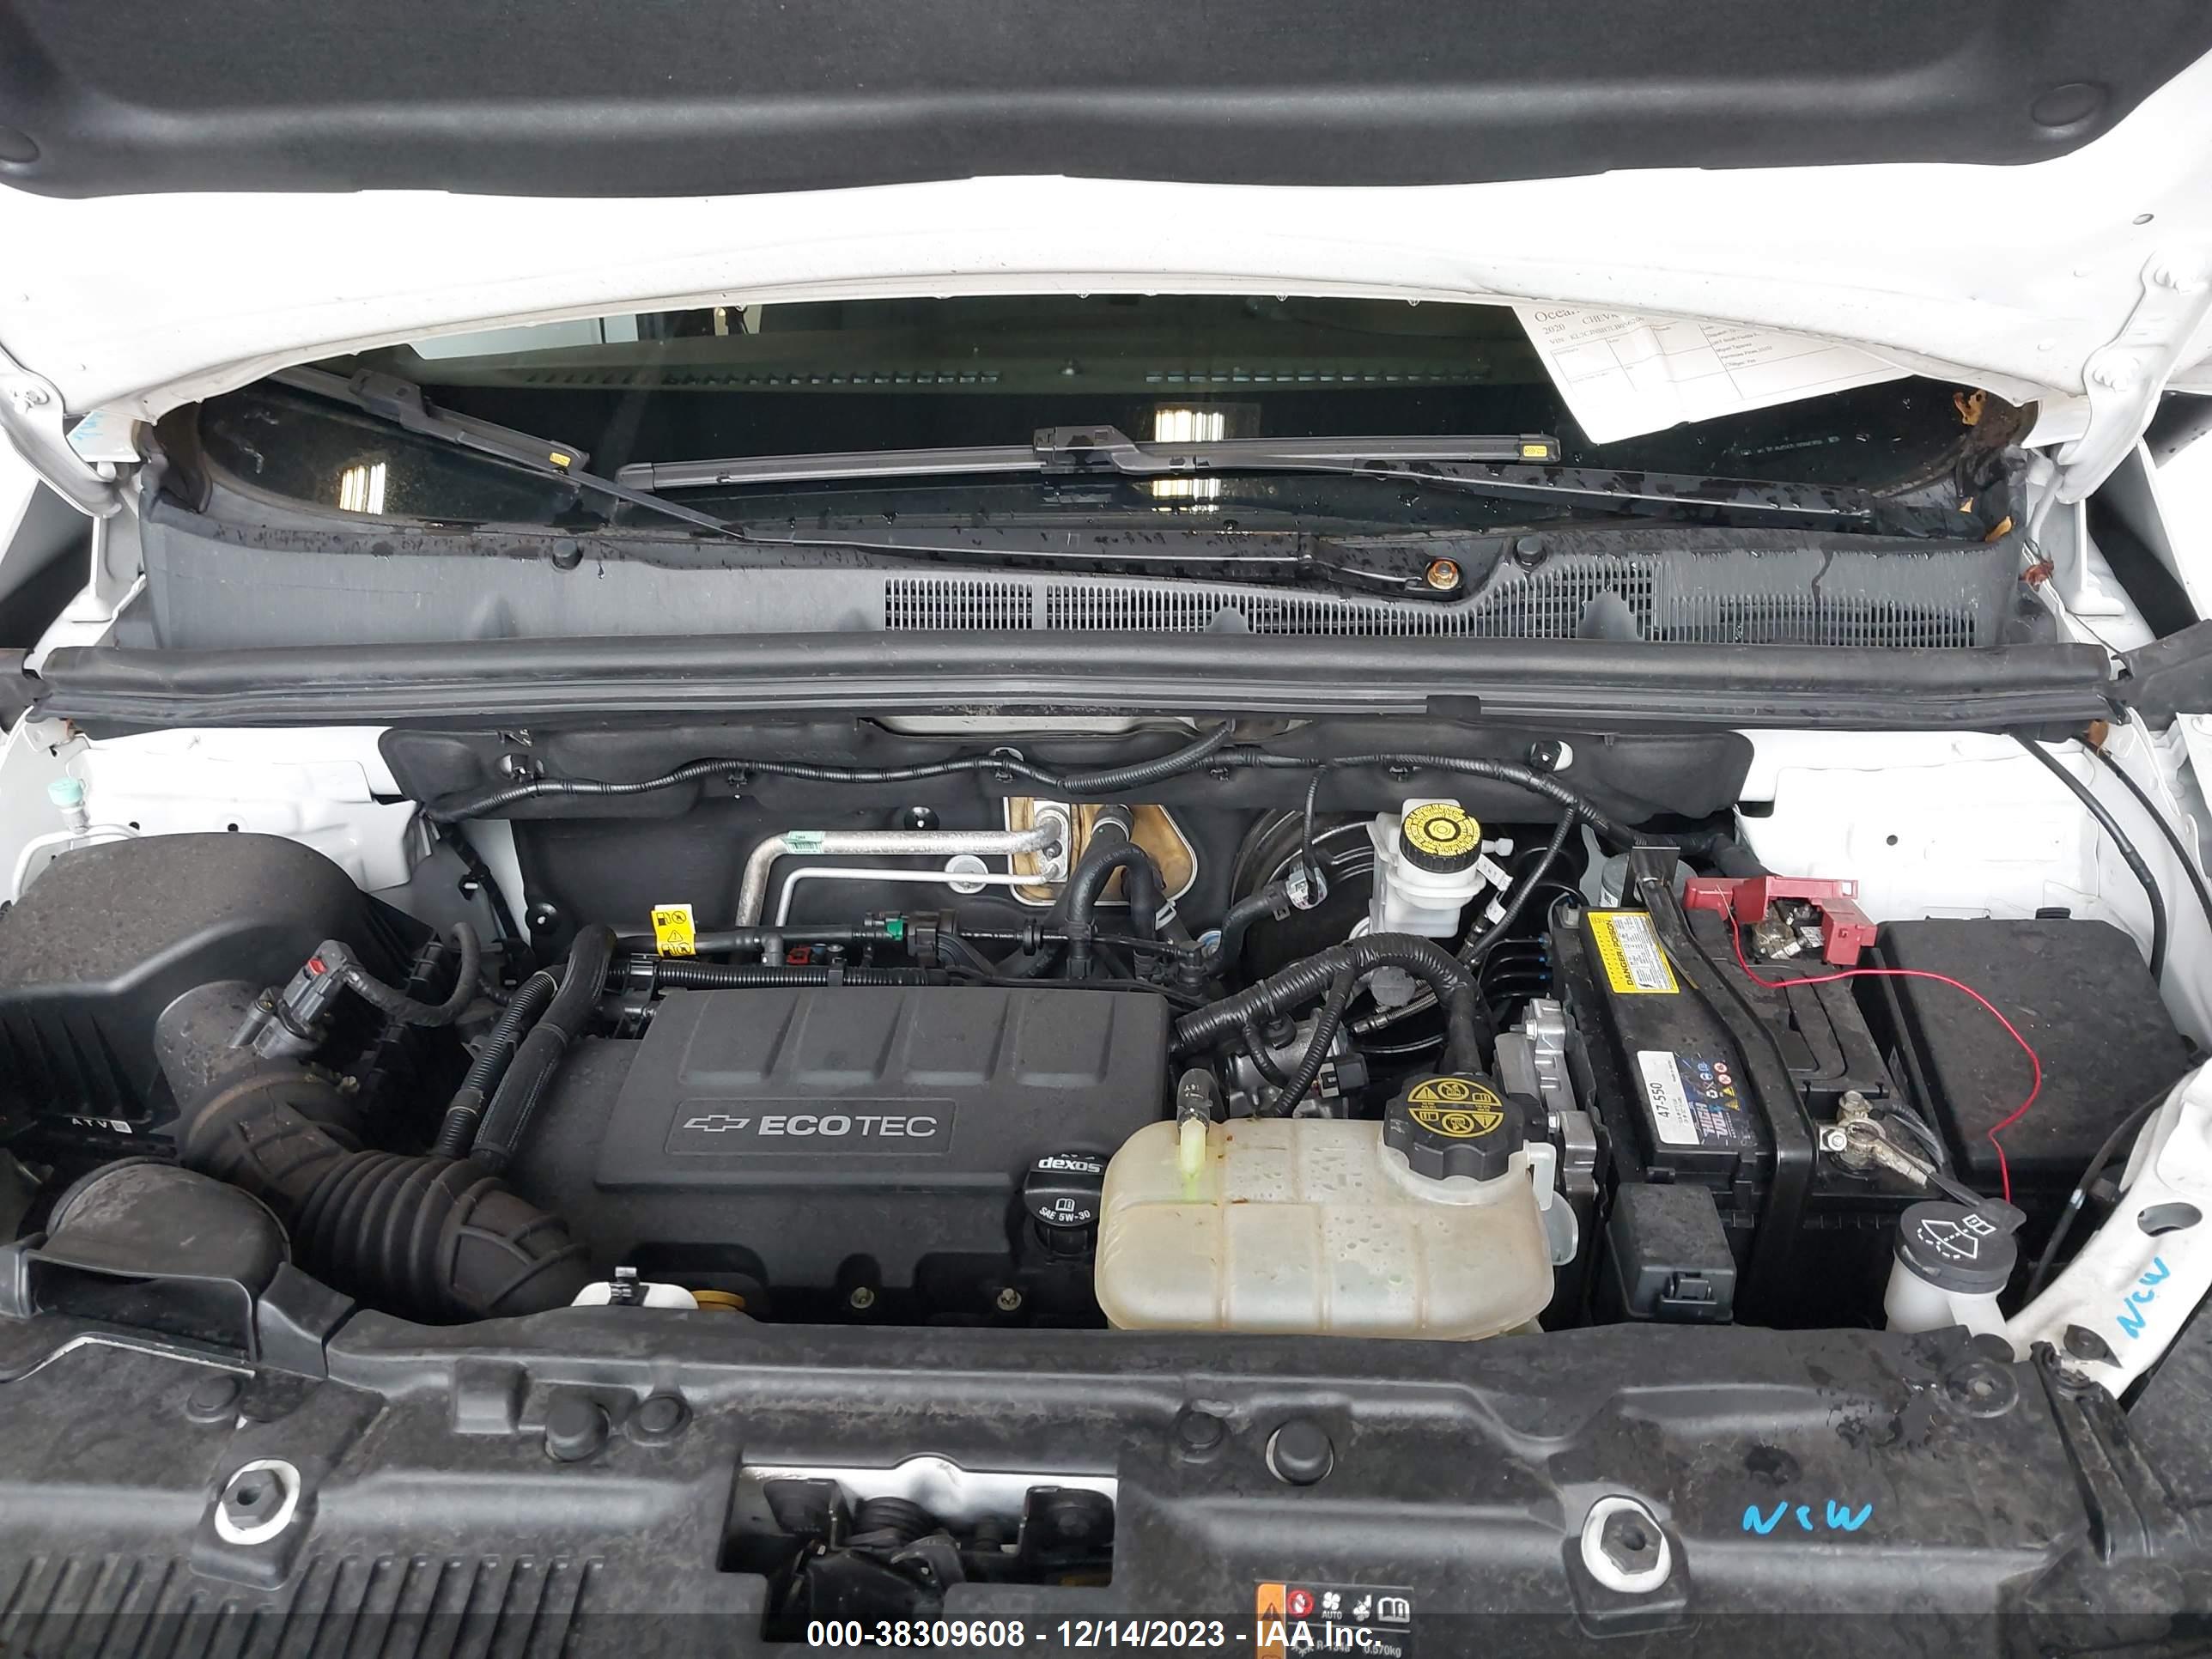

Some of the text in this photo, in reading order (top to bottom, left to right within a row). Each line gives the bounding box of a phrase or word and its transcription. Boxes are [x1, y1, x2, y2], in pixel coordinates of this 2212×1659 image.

[1543, 323, 1566, 335] 2020
[1650, 1082, 1669, 1118] 47-550
[758, 1115, 938, 1138] ECOTEC
[1038, 1157, 1103, 1173] dexos
[1039, 1206, 1091, 1222] SAE 5W-30
[1321, 1611, 1343, 1620] AUTO
